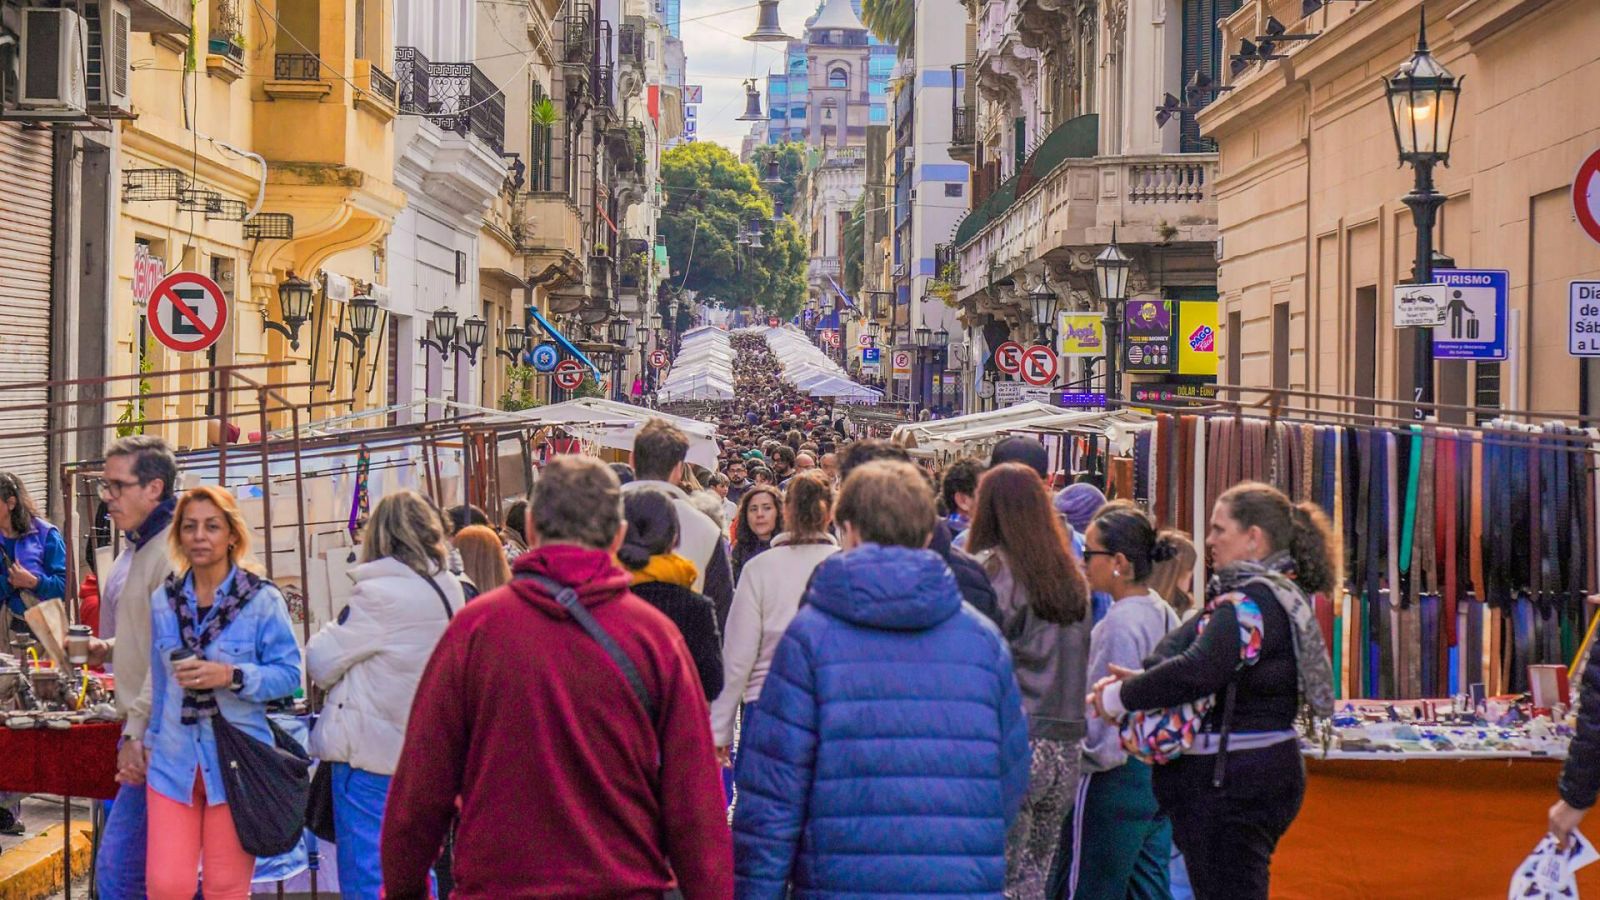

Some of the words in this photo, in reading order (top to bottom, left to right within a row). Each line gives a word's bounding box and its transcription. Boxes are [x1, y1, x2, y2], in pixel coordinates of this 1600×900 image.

[1434, 275, 1491, 285] TURISMO
[172, 288, 204, 334] E
[1580, 304, 1599, 316] de
[1190, 326, 1212, 349] PAGO
[1578, 341, 1586, 350] a
[867, 350, 873, 359] E
[1004, 349, 1017, 366] E
[1031, 354, 1047, 377] E
